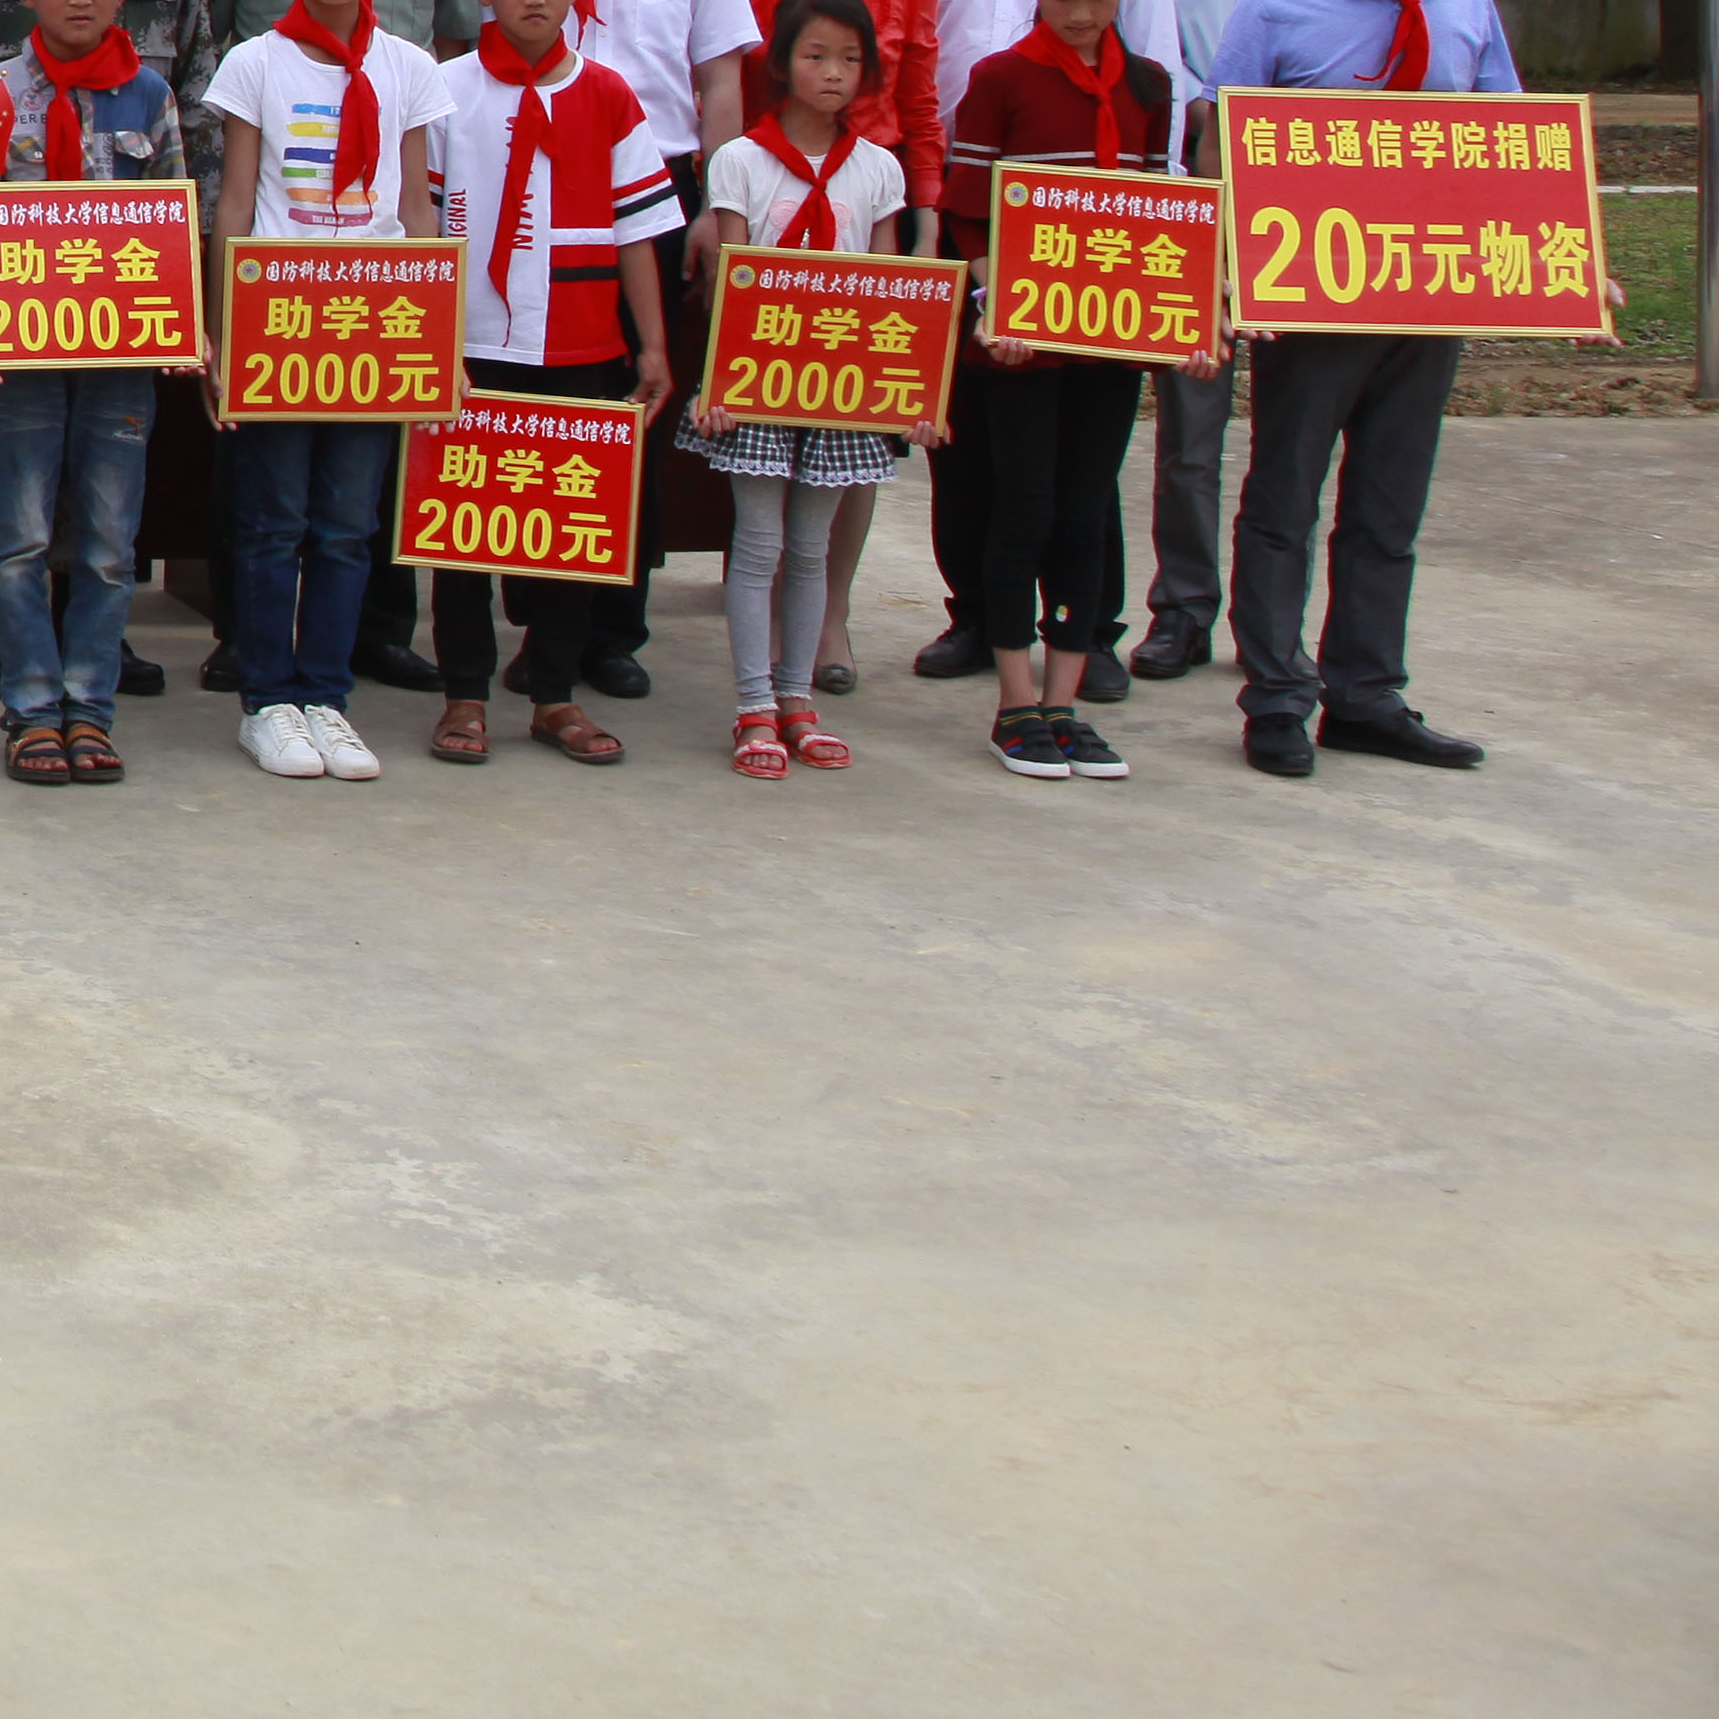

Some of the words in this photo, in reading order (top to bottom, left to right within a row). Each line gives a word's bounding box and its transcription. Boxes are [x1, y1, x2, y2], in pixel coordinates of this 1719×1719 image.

[1241, 117, 1572, 171] 信息通信学院捐赠
[1032, 186, 1216, 225] 国防科技大学信息通信学院
[266, 258, 455, 283] 国防科技大学信息通信学院
[1029, 223, 1188, 279] 助学金
[1250, 206, 1590, 304] 20万元物资
[759, 268, 952, 302] 国防科技大学信息通信学院
[263, 295, 427, 340] 助学金
[751, 304, 918, 354] 助学金
[1008, 278, 1200, 348] 2000元
[242, 353, 440, 404] 2000元
[723, 356, 925, 419] 2000元
[438, 444, 602, 499] 助学金
[414, 498, 613, 567] 2000元
